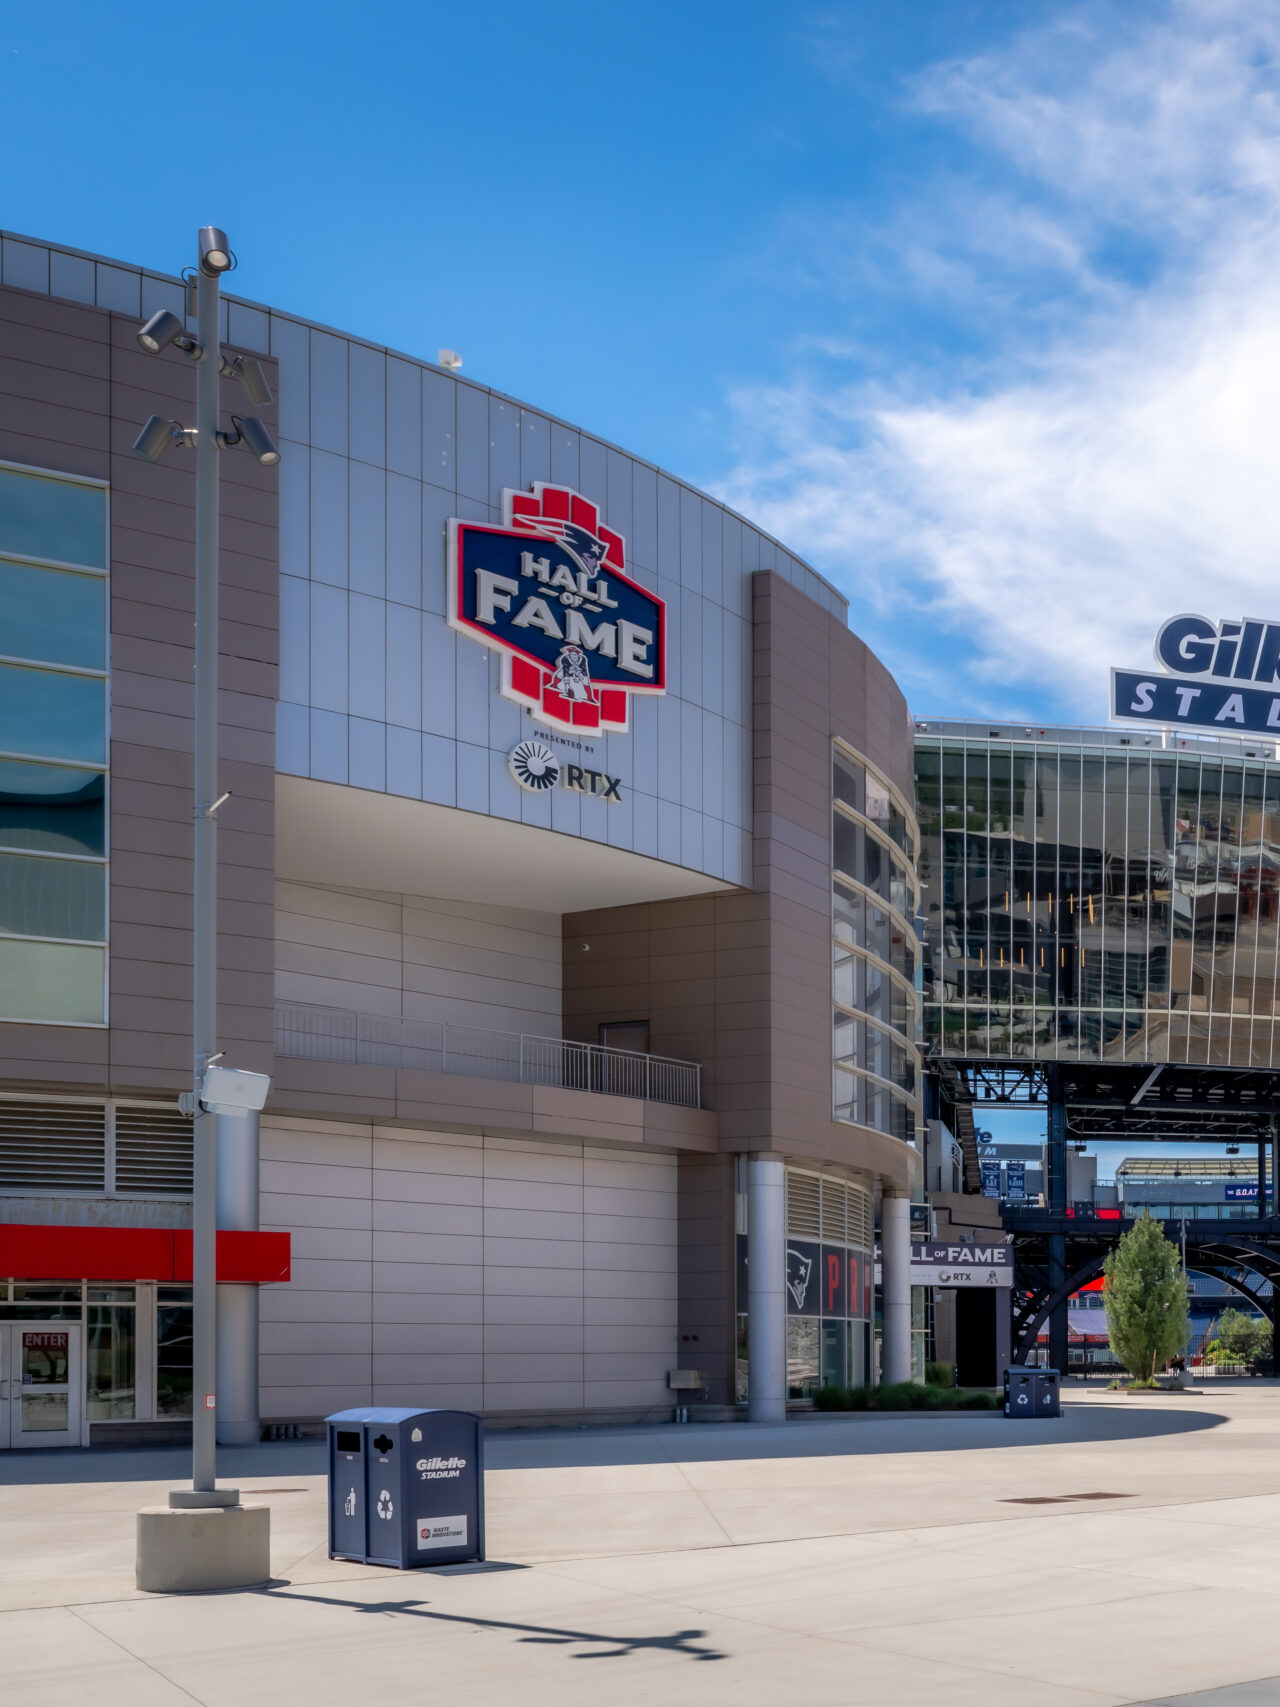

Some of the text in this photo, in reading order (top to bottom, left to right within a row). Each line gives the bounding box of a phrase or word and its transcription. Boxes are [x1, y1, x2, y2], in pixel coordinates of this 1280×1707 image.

[520, 551, 618, 608] HALL
[559, 592, 583, 607] OF
[474, 568, 653, 678] FAME
[534, 730, 595, 754] PRESENTED BY
[566, 763, 622, 802] RTX
[934, 1250, 946, 1258] OF
[947, 1246, 1006, 1263] FAME
[953, 1273, 971, 1281] RTX
[24, 1334, 67, 1346] ENTER
[416, 1457, 467, 1471] Gillette
[421, 1470, 460, 1480] STADIUM
[431, 1530, 463, 1539] INNOVATIONS
